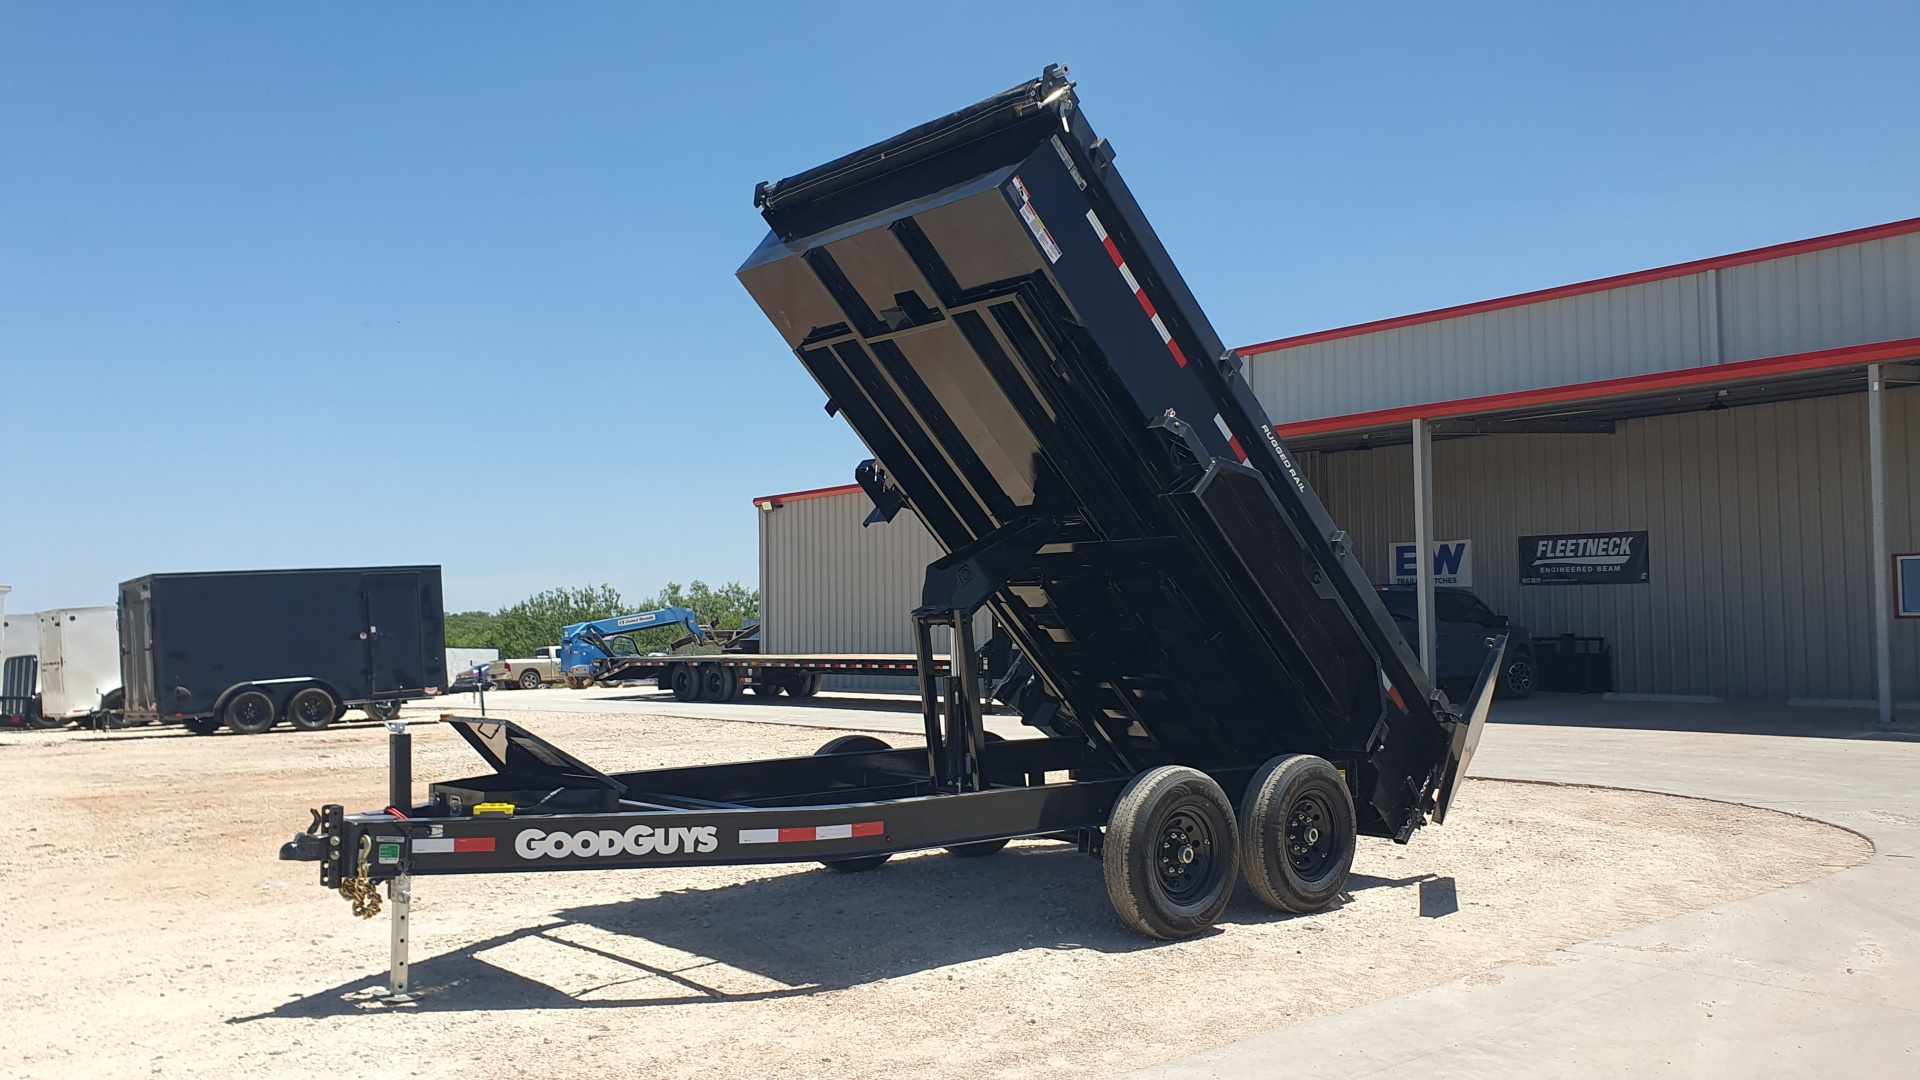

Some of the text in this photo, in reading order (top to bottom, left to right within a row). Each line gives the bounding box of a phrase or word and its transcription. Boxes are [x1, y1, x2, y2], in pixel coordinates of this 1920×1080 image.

[1261, 424, 1305, 493] RUGGED RAIL
[1536, 537, 1634, 557] FLEETNECK
